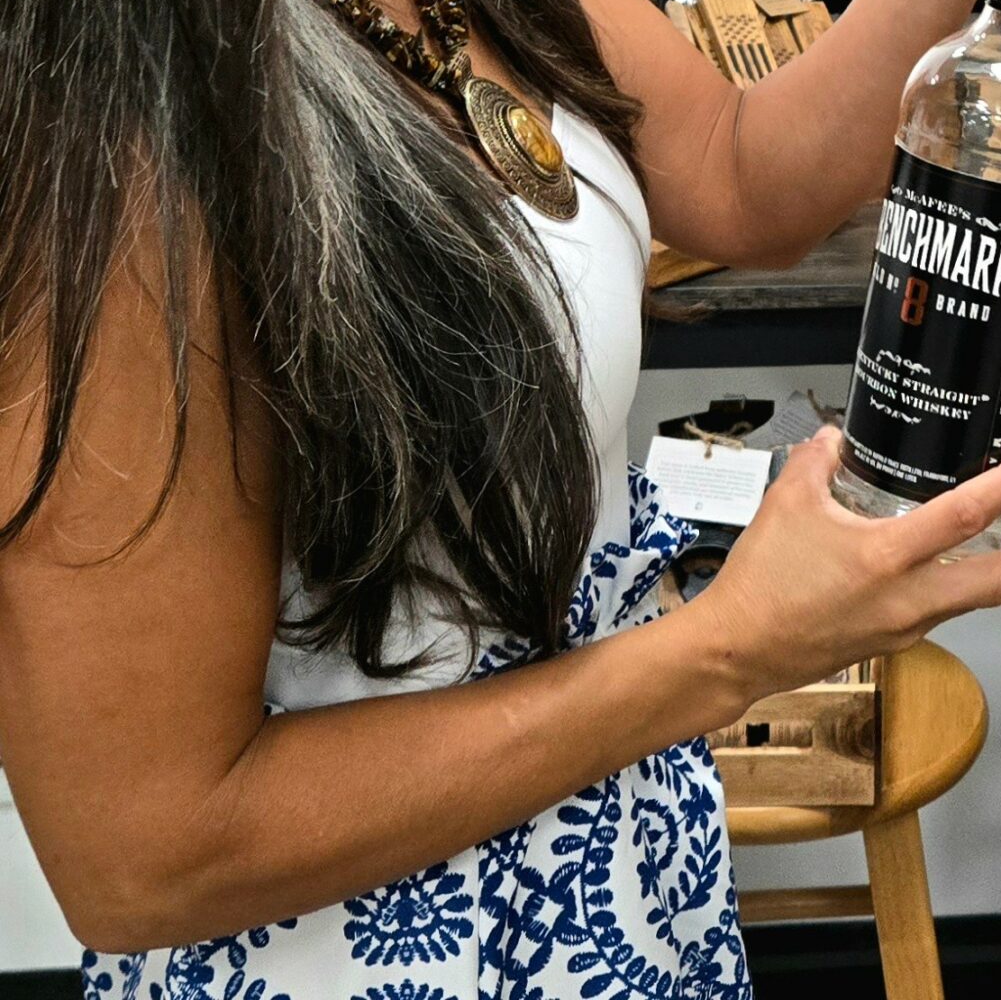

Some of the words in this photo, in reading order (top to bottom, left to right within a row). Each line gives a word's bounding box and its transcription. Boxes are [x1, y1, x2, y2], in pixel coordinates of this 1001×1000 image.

[901, 275, 929, 326] 8
[935, 293, 991, 323] BRAND
[901, 392, 971, 420] WHISKEY
[902, 377, 979, 406] STRAIGHT
